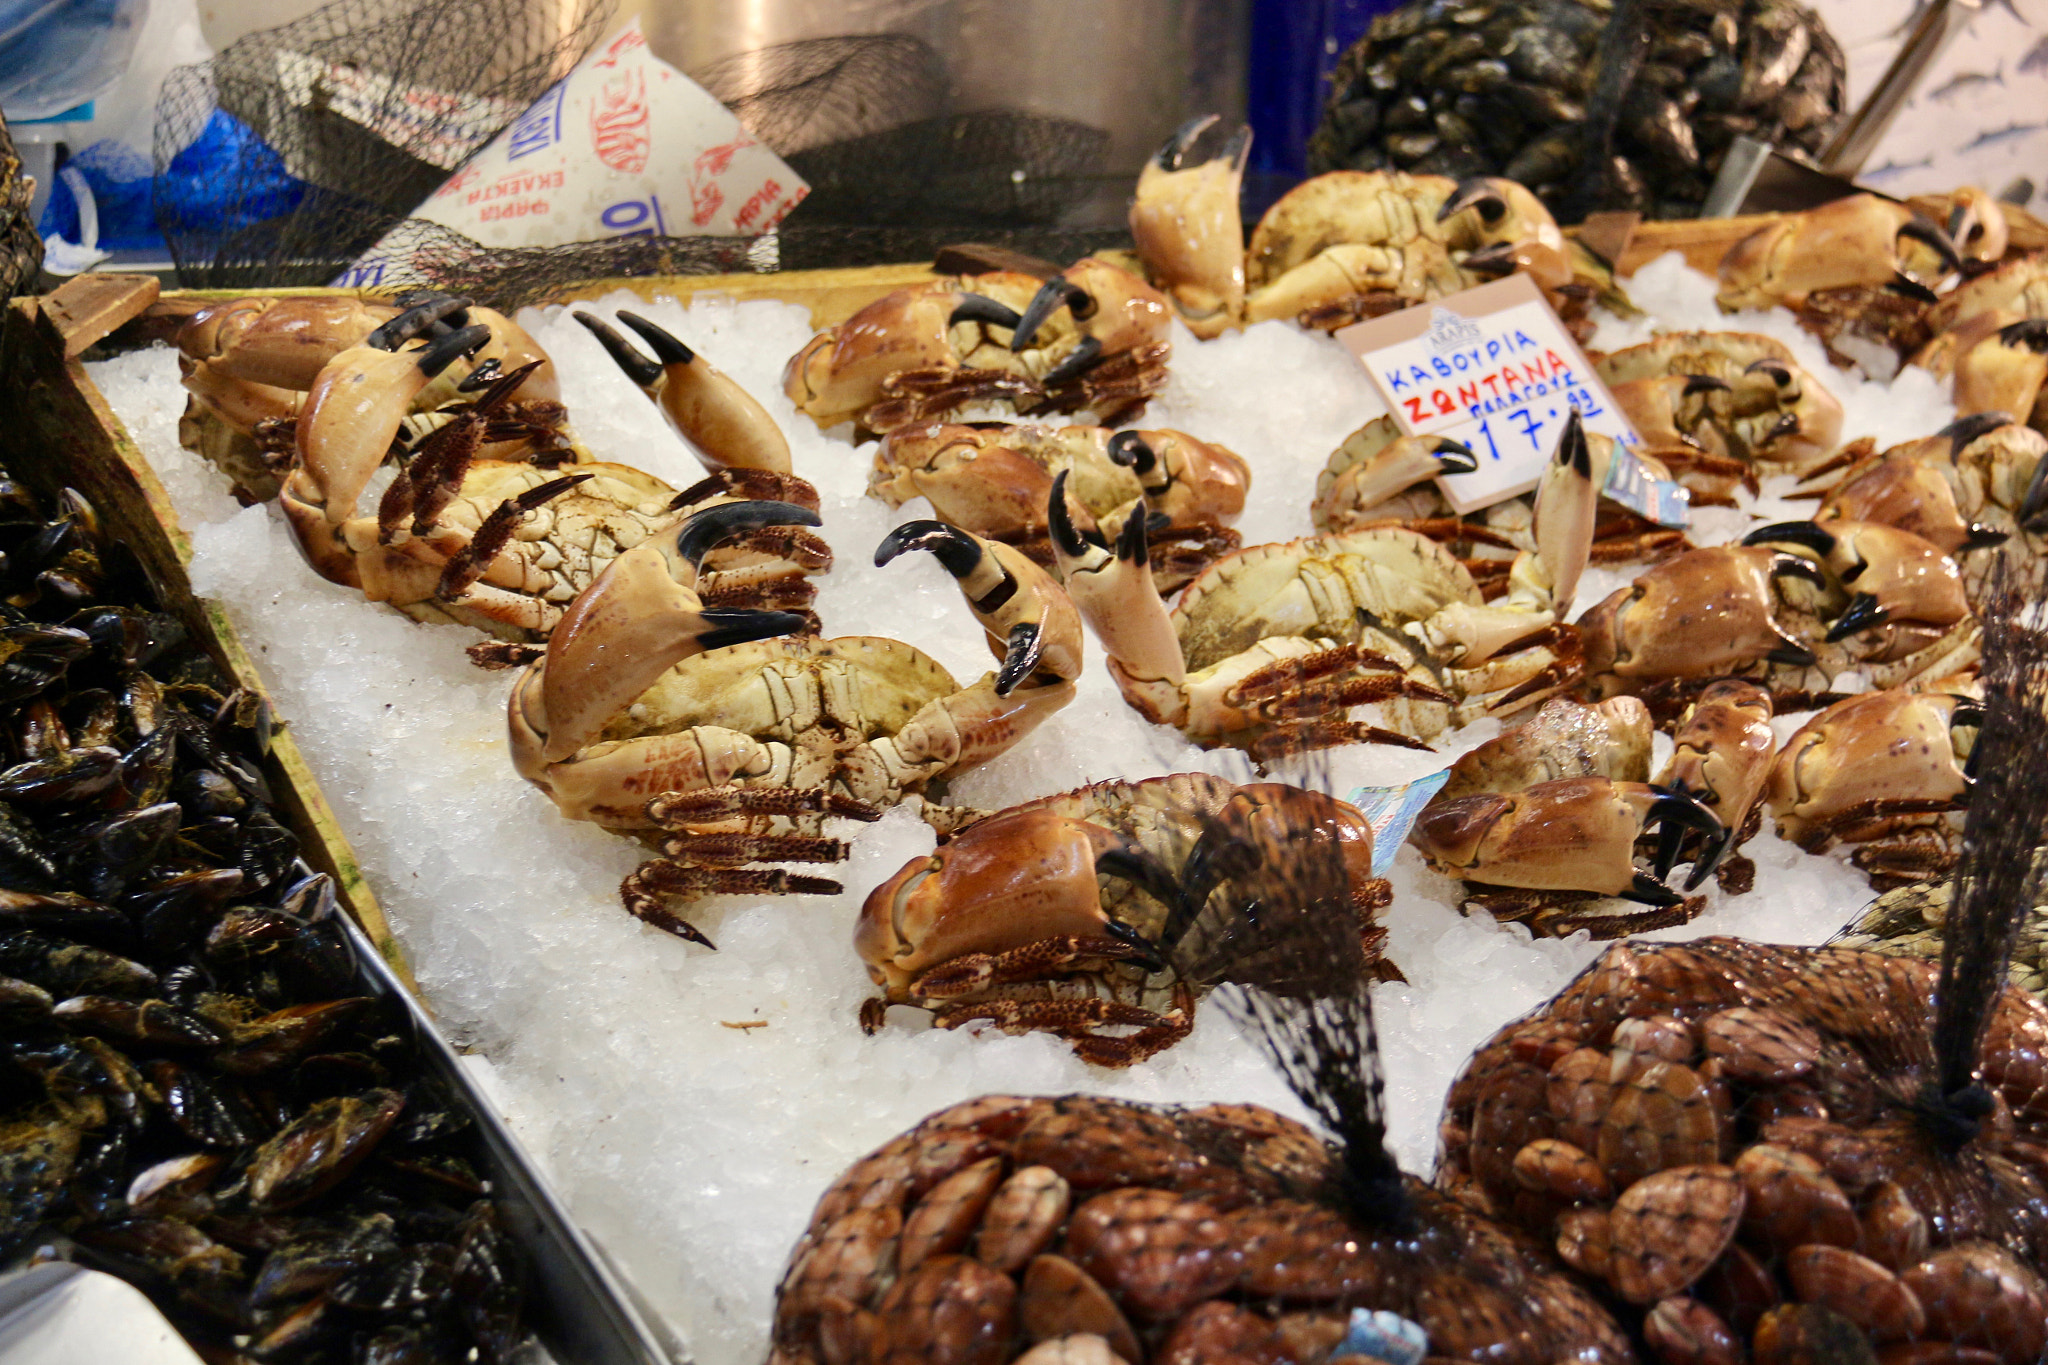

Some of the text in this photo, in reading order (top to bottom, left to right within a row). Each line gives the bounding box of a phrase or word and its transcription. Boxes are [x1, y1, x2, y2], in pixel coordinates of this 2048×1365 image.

[467, 169, 565, 205] ΕΚΛΕΚΤΑ
[1387, 330, 1537, 393] ΚΑΒΟΥΡΙΑ
[1403, 348, 1572, 424] ΖΩΝΤΑΝΑ
